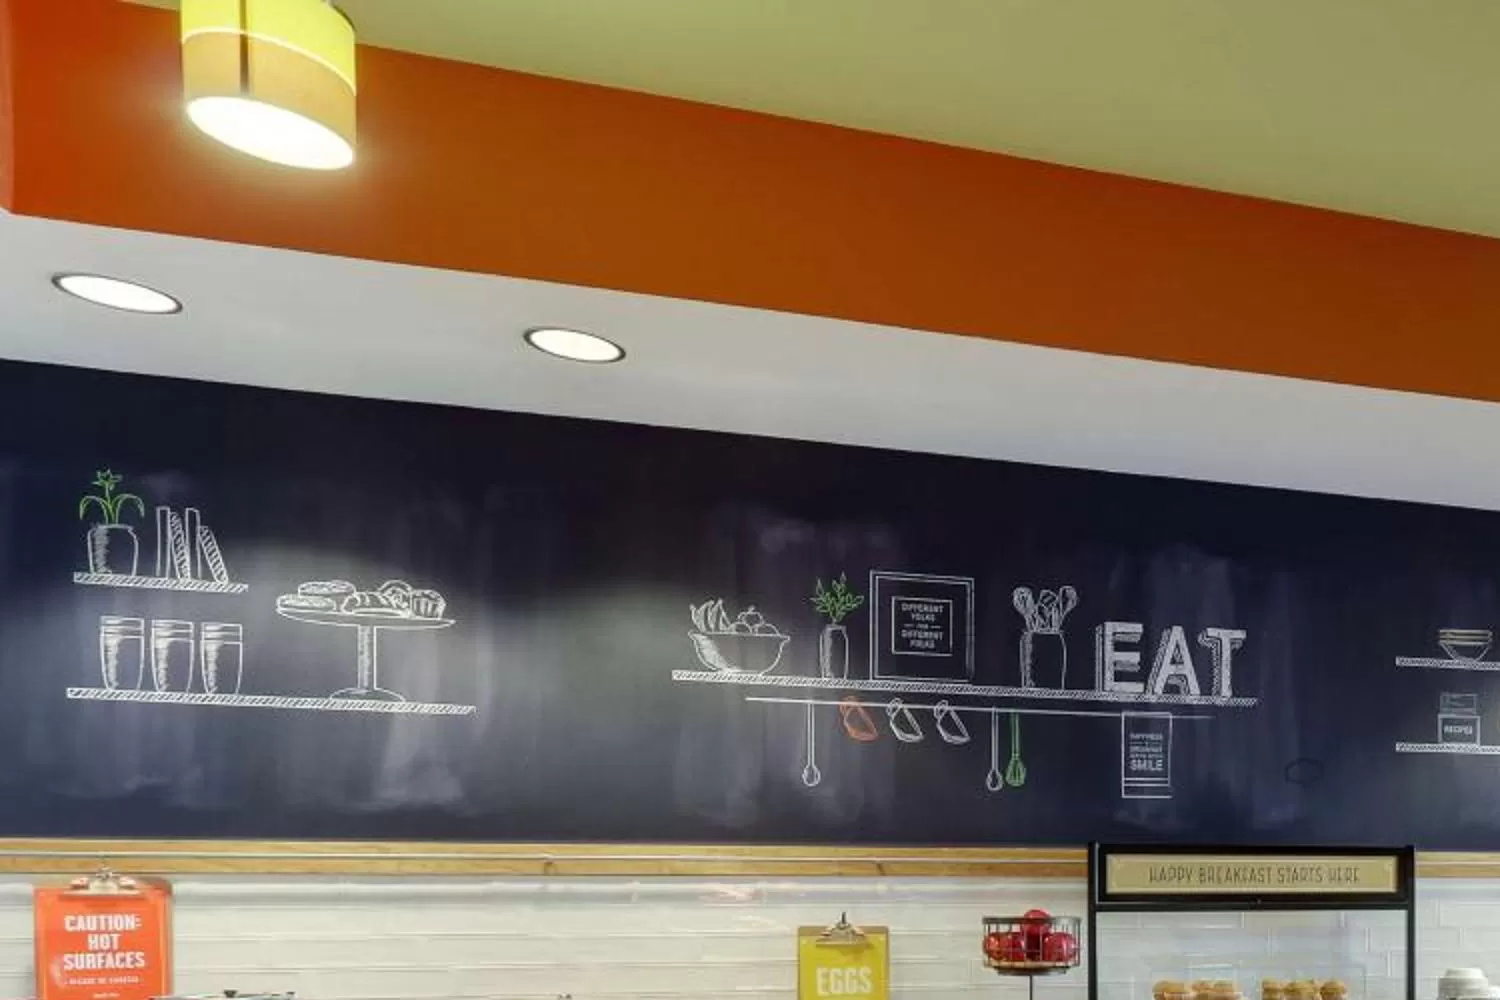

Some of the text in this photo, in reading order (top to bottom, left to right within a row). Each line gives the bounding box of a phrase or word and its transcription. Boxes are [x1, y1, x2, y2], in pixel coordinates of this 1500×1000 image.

[1096, 621, 1247, 698] EAT
[1129, 759, 1164, 771] SMILE
[1150, 866, 1360, 885] HAPPY BREAKFAST STARTS HERE
[64, 912, 142, 932] CAUTION:
[87, 933, 121, 951] HOT
[64, 951, 145, 971] SURFACES
[816, 966, 873, 996] EGGS
